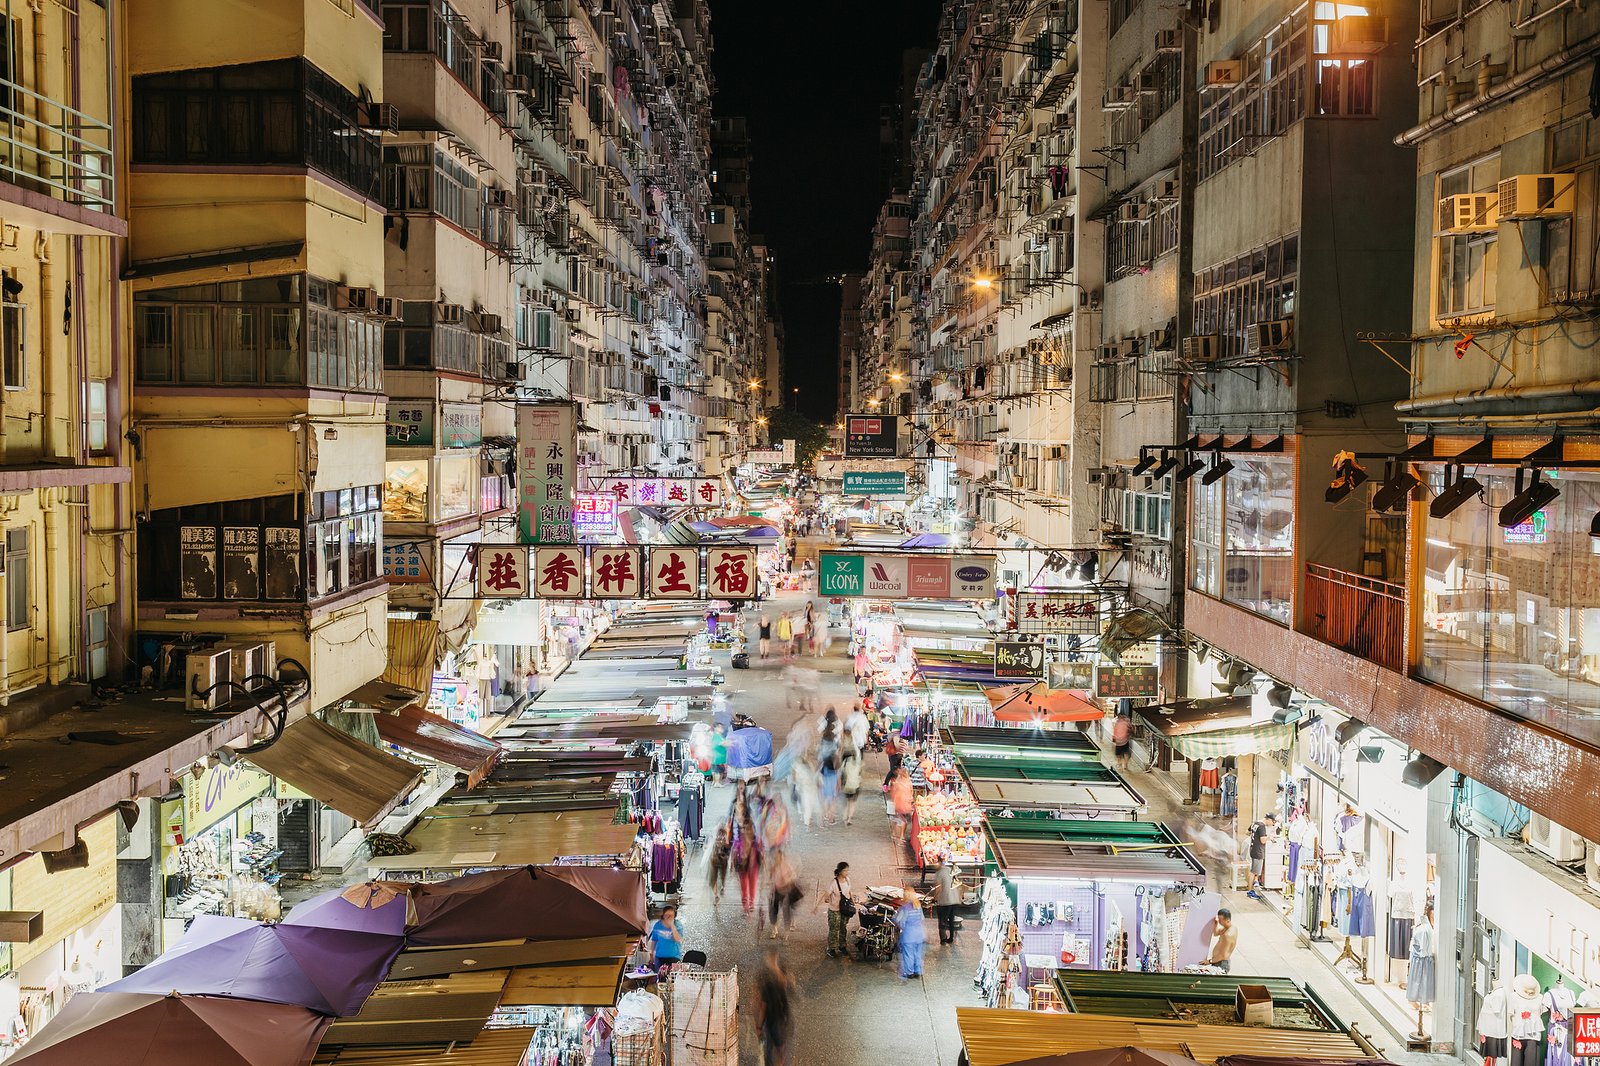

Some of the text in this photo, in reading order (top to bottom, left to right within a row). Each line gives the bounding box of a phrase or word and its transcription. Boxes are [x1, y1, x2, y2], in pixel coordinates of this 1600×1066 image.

[524, 446, 536, 496] 請上一樓
[546, 441, 564, 500] 永興隆
[577, 499, 612, 513] 足跡
[576, 513, 612, 523] 正宗按摩
[181, 528, 215, 543] 雅美姿
[224, 530, 258, 544] 雅美姿
[266, 528, 300, 543] 雅美姿
[915, 574, 943, 583] Triumph
[869, 581, 902, 591] Wacoal
[1024, 601, 1096, 619] 美斯髮廊
